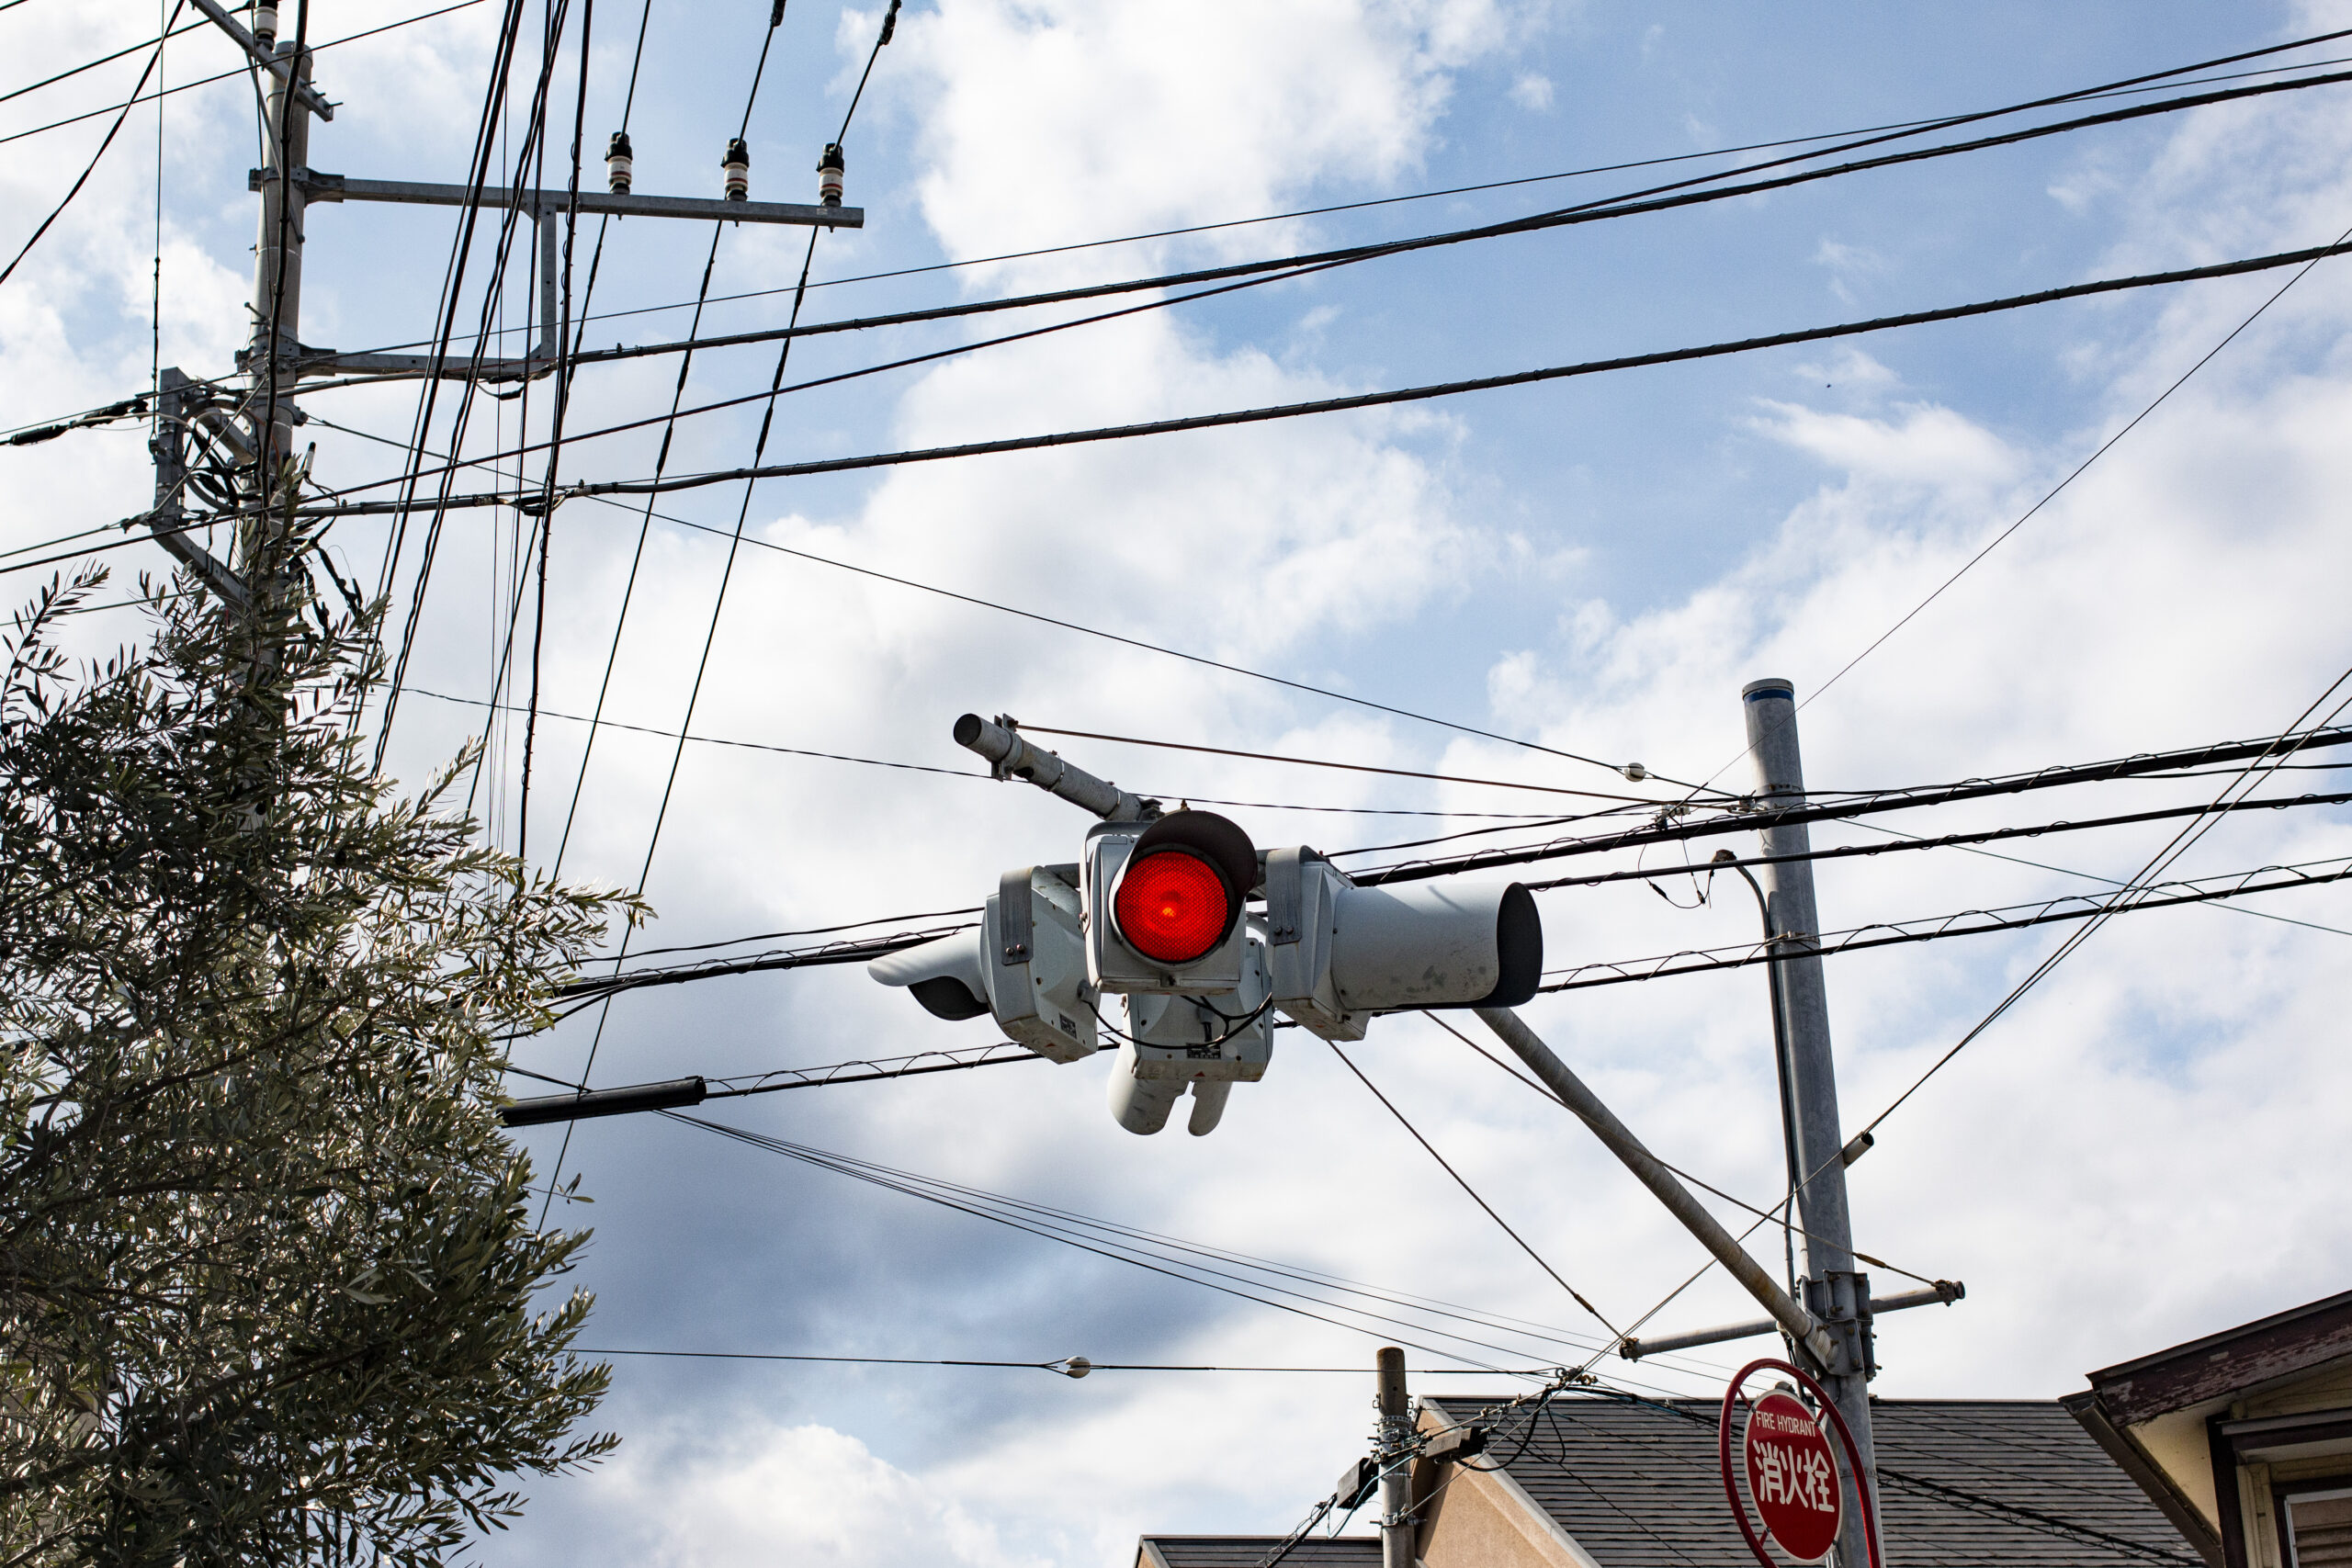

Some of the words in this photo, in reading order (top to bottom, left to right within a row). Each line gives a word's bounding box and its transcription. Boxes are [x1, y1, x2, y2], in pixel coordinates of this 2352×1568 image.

[1756, 1411, 1775, 1429] FIRE
[1777, 1415, 1815, 1437] HYDRANT
[1752, 1439, 1835, 1512] 消火栓
